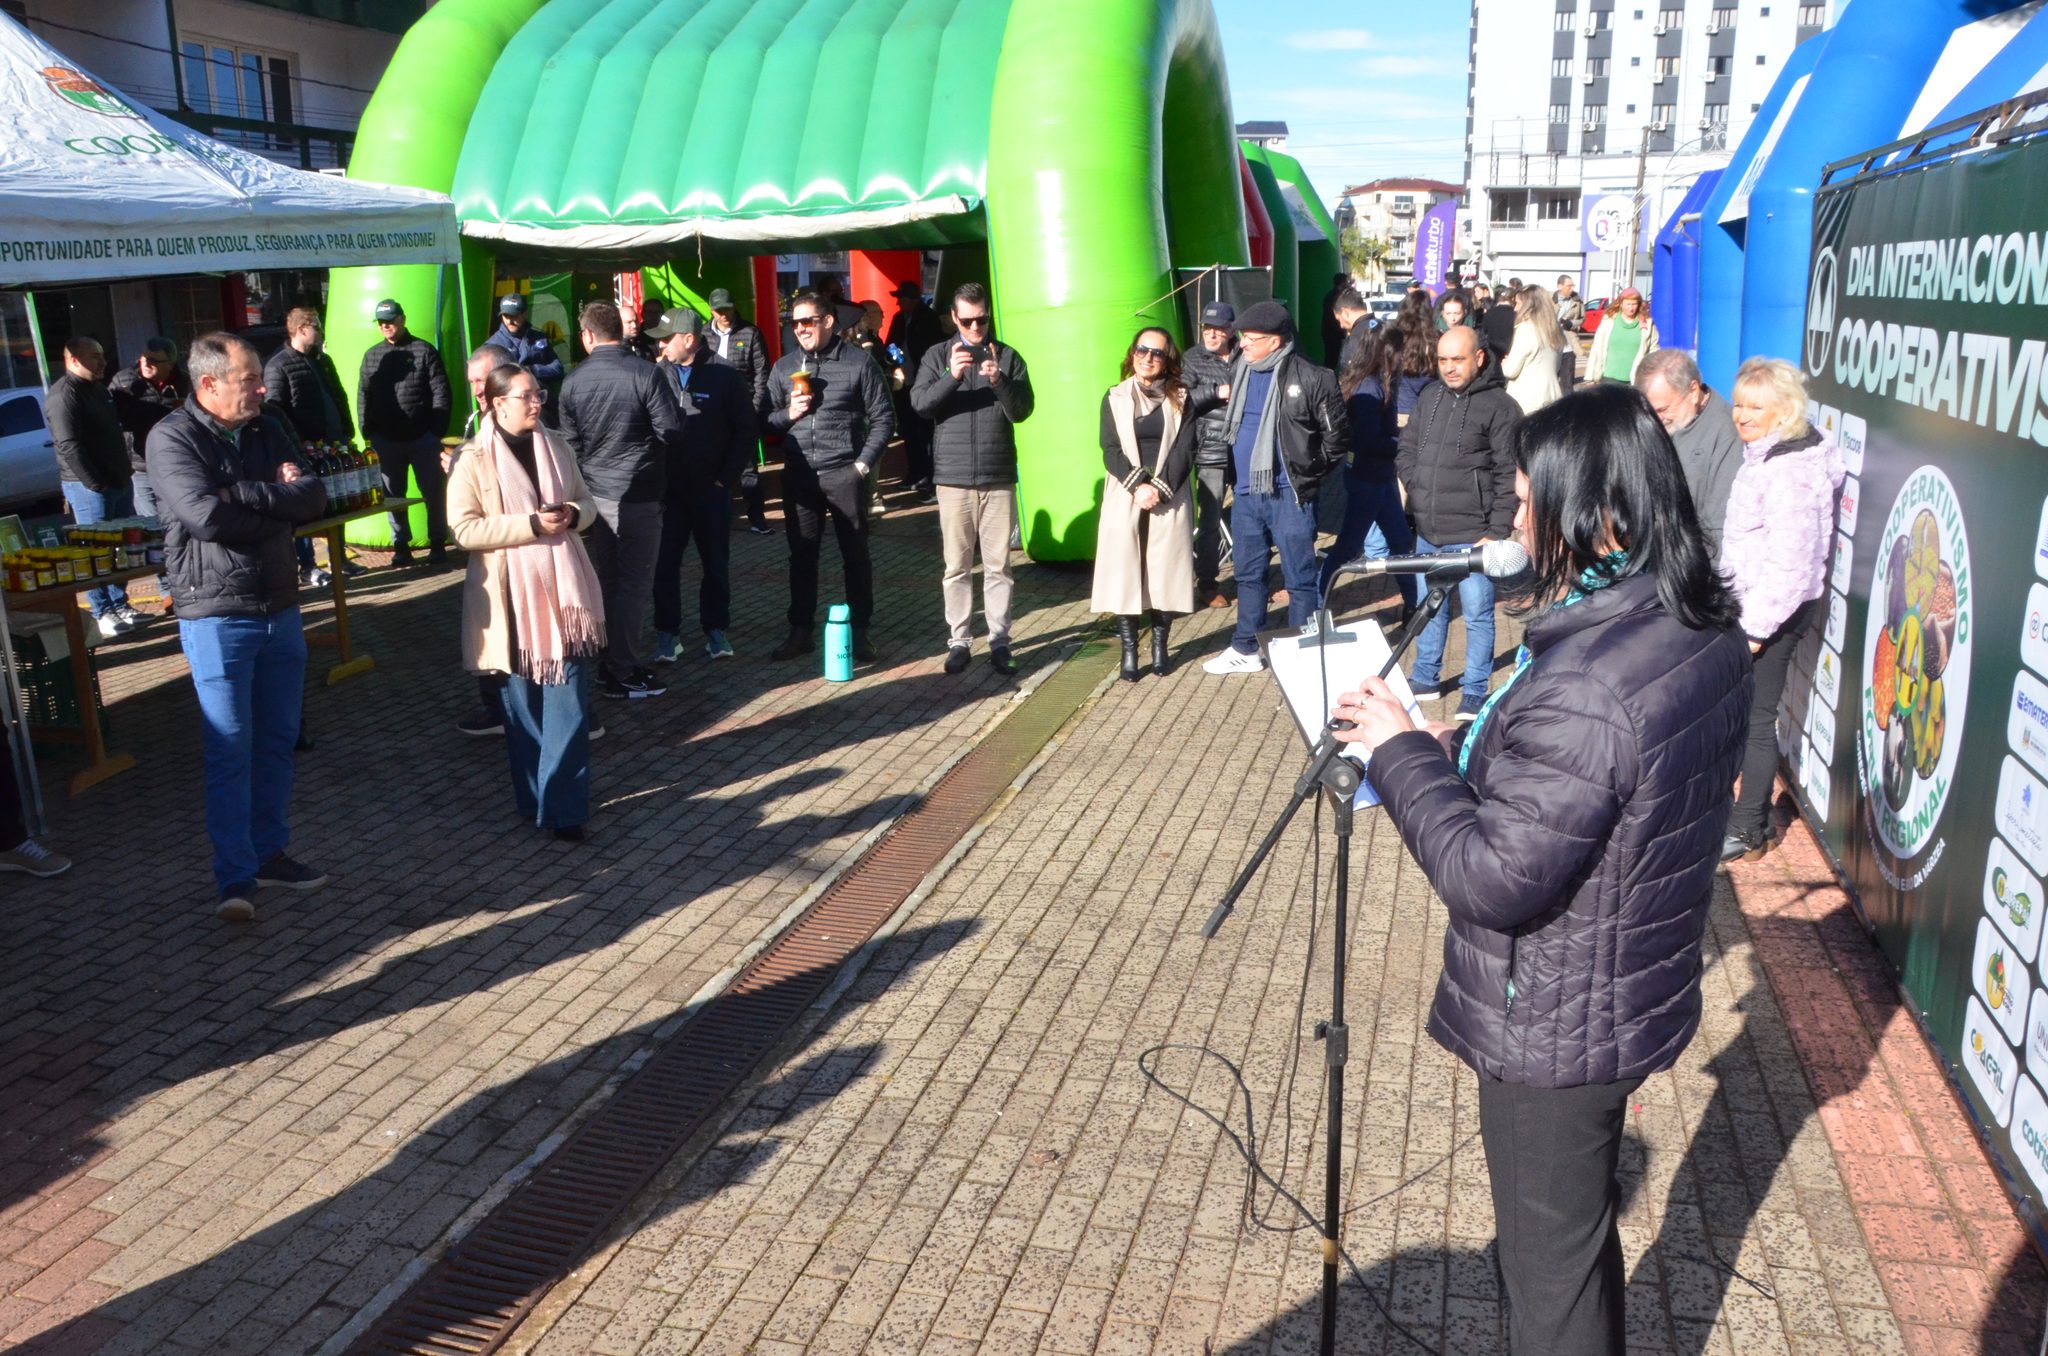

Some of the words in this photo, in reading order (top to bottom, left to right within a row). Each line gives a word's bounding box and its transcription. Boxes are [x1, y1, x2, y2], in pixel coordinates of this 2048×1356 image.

[0, 239, 112, 262] PORTUNIDADE
[117, 238, 153, 257] PARA
[156, 237, 194, 256] QUEM
[199, 235, 255, 254] PRODUZ,
[255, 234, 326, 255] SEGURANÇA
[326, 233, 355, 249] PARA
[357, 233, 386, 248] QUEM
[387, 231, 436, 247] CONSOME!
[1846, 245, 1876, 297] DIA
[1877, 230, 2048, 305] INTERNACION
[1878, 475, 1968, 644] COOPERATIVISMO
[1881, 775, 1947, 849] REGIONAL
